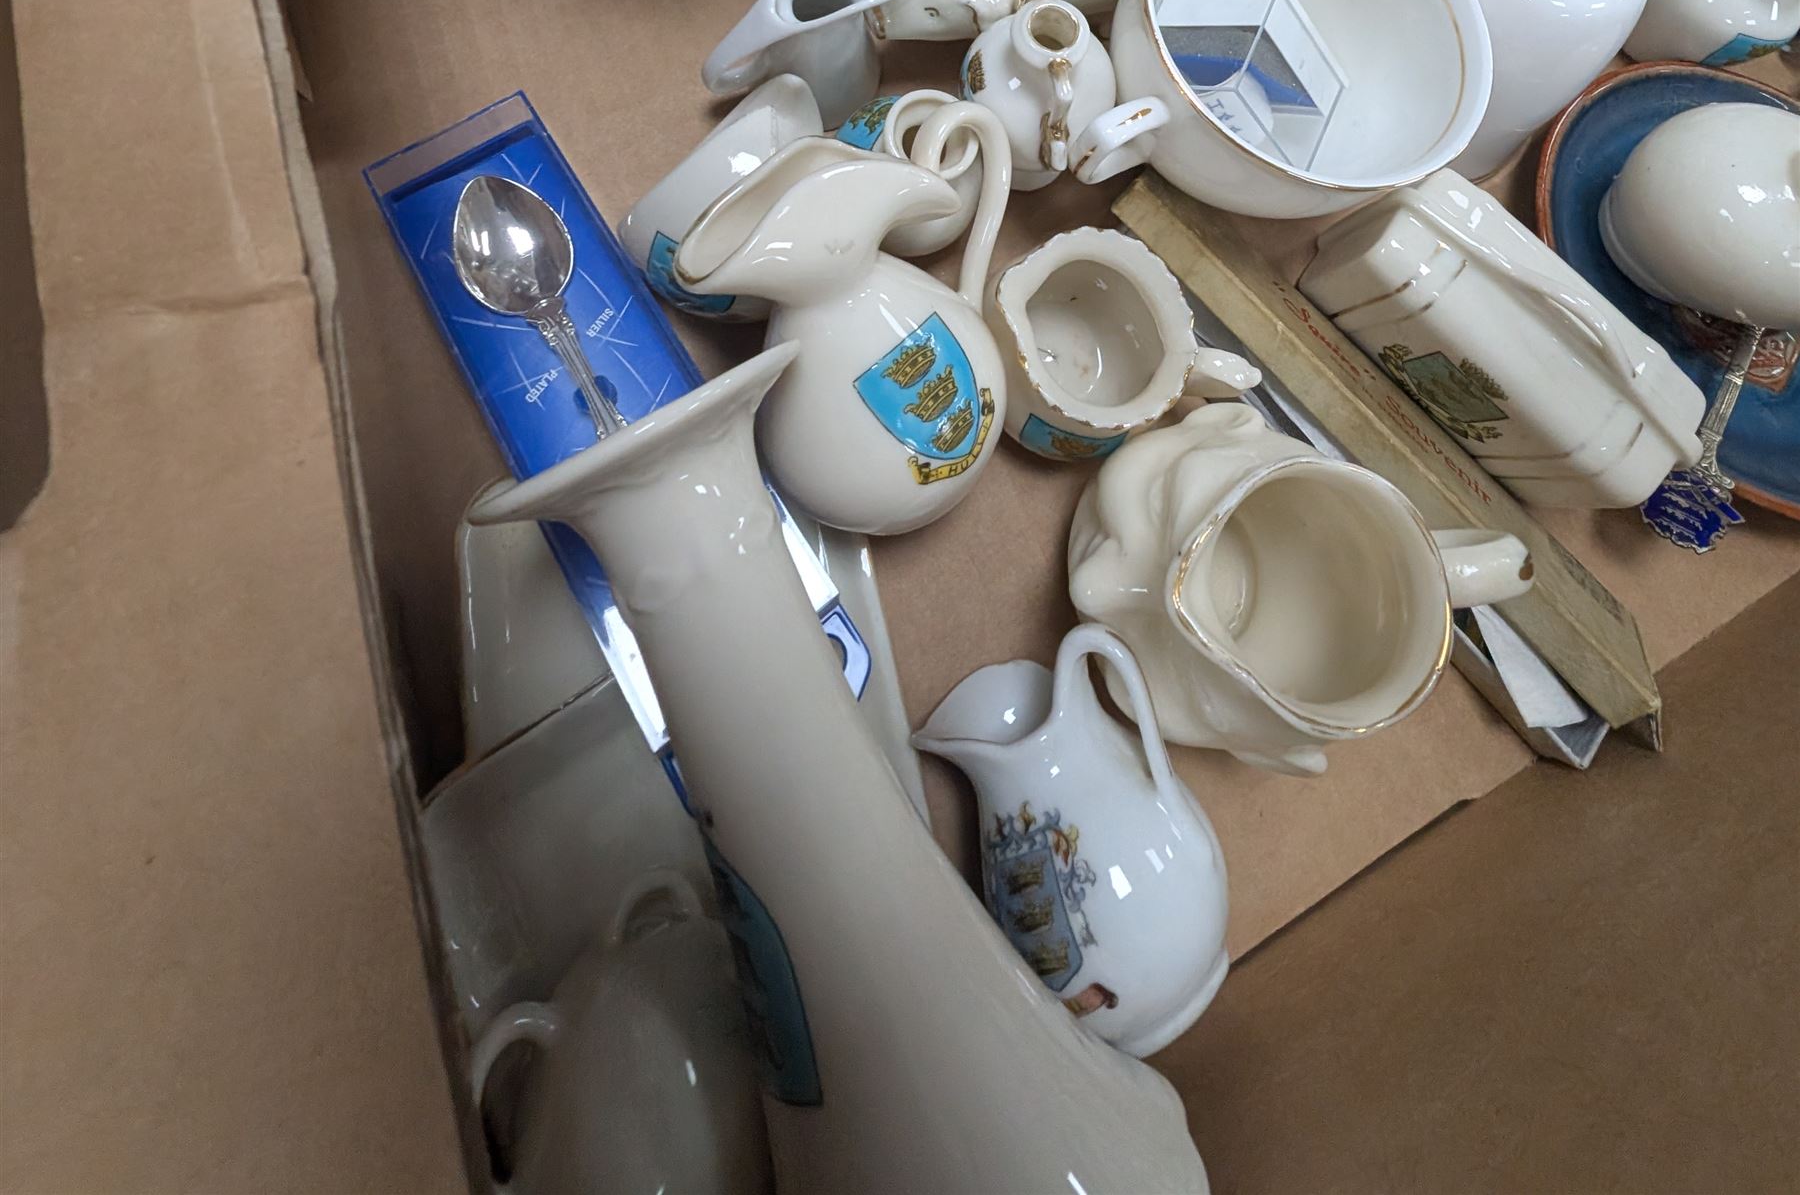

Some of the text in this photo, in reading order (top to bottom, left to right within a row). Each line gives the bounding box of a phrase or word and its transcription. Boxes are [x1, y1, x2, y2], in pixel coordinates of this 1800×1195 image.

[586, 307, 615, 339] SILVER
[525, 368, 559, 404] PLATED
[947, 441, 985, 476] HULL
[1385, 394, 1493, 505] Souvenir
